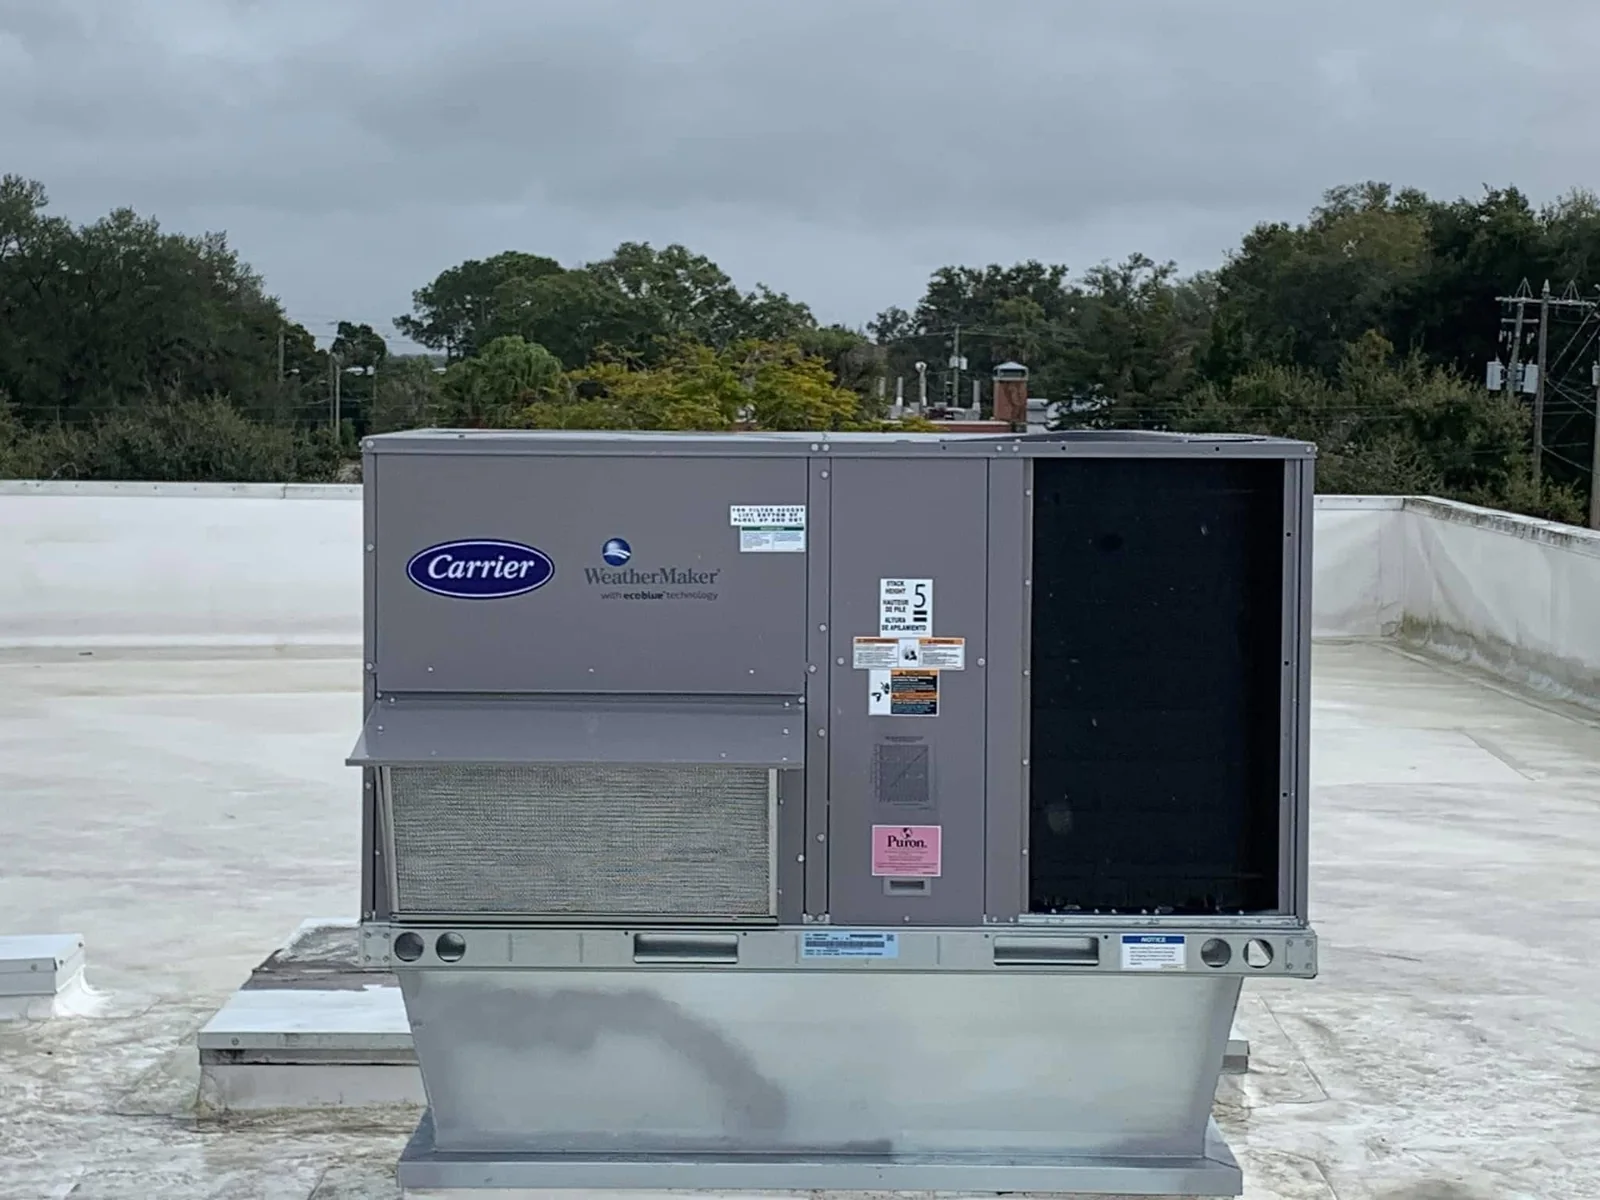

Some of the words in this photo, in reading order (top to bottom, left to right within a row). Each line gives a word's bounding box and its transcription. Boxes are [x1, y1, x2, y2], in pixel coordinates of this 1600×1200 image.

[427, 554, 535, 580] Carrier
[584, 567, 719, 585] WeatherMaker
[600, 591, 622, 600] with
[666, 591, 719, 601] technology
[913, 583, 926, 608] 5
